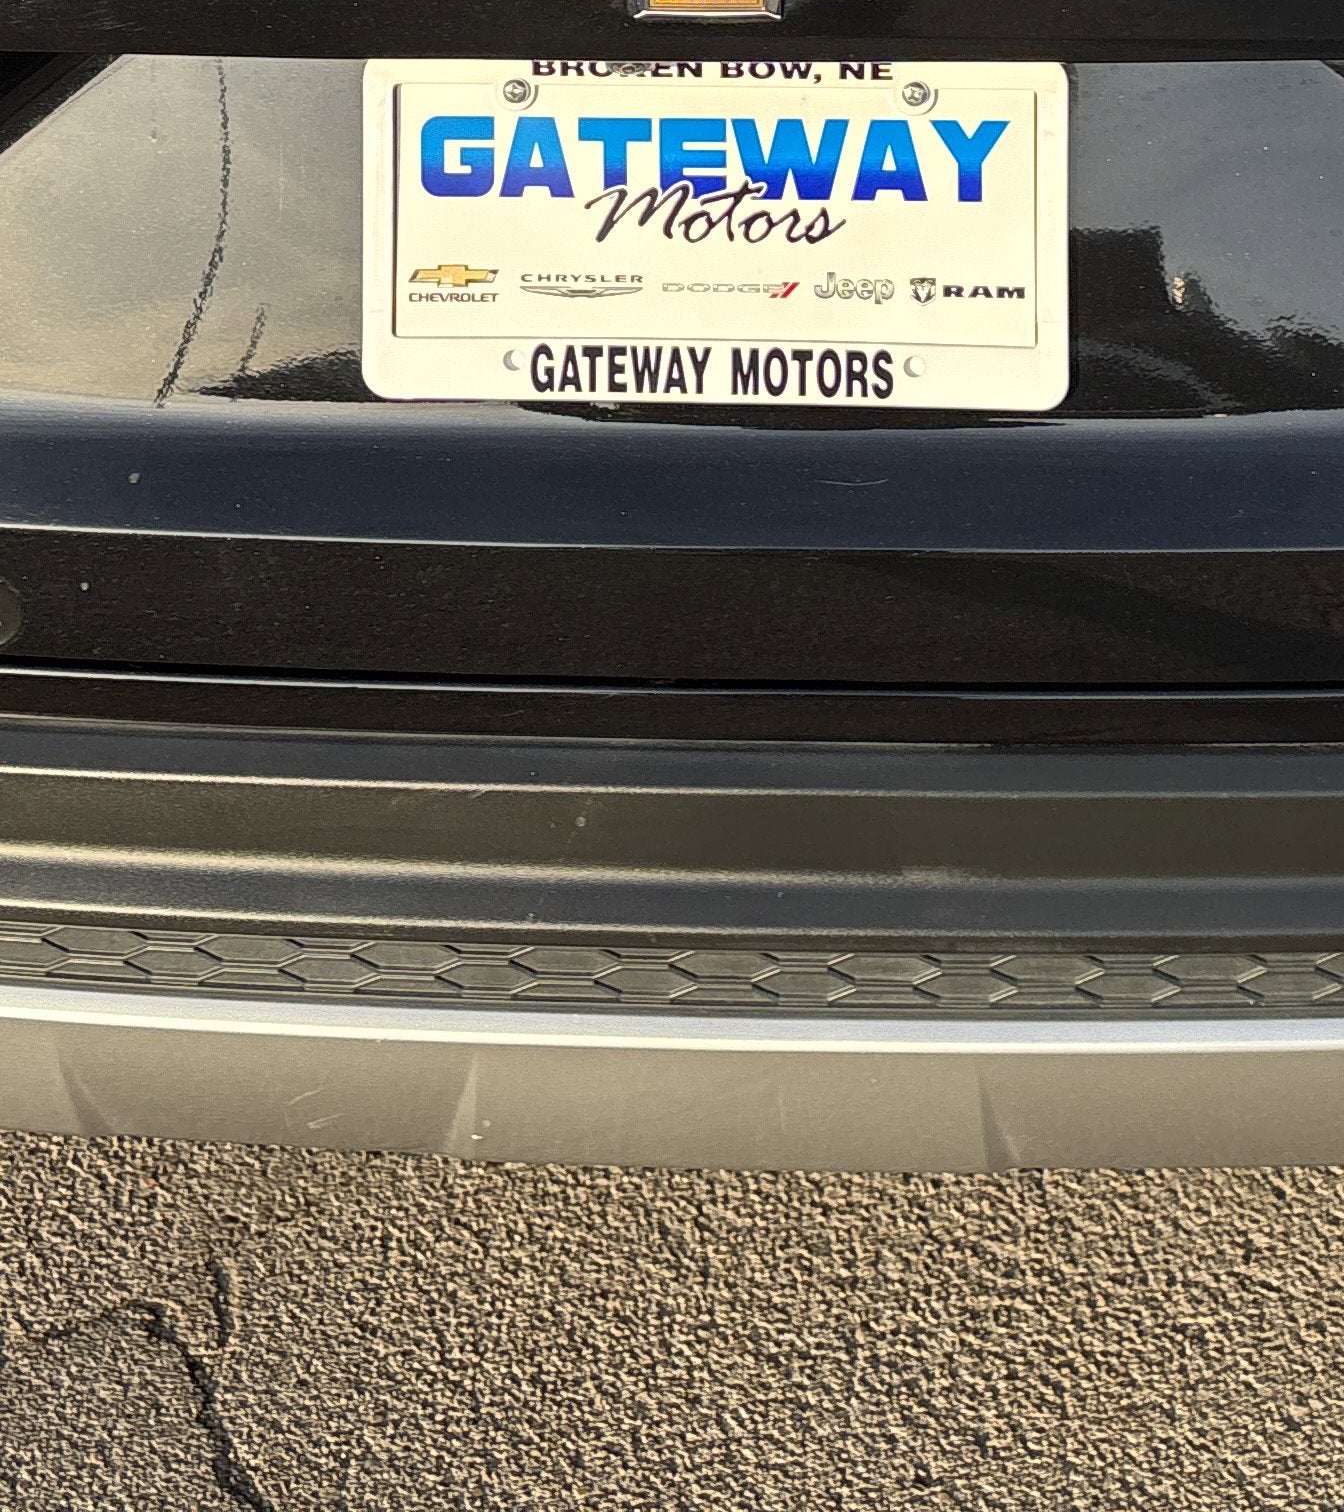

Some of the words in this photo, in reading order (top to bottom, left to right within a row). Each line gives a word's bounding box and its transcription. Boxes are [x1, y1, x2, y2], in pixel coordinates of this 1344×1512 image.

[532, 60, 702, 78] BROEN
[720, 61, 822, 84] BOW,
[839, 62, 893, 80] NE
[420, 116, 1009, 202] GATEWAY
[585, 179, 846, 244] Motors
[520, 273, 644, 284] CHRYSLER
[662, 282, 786, 294] DODGE
[814, 272, 895, 305] Jeep
[408, 292, 499, 303] CHEVROLET
[942, 284, 1026, 300] RAM
[529, 343, 712, 395] GATEWAY
[731, 347, 895, 399] MOTORS
